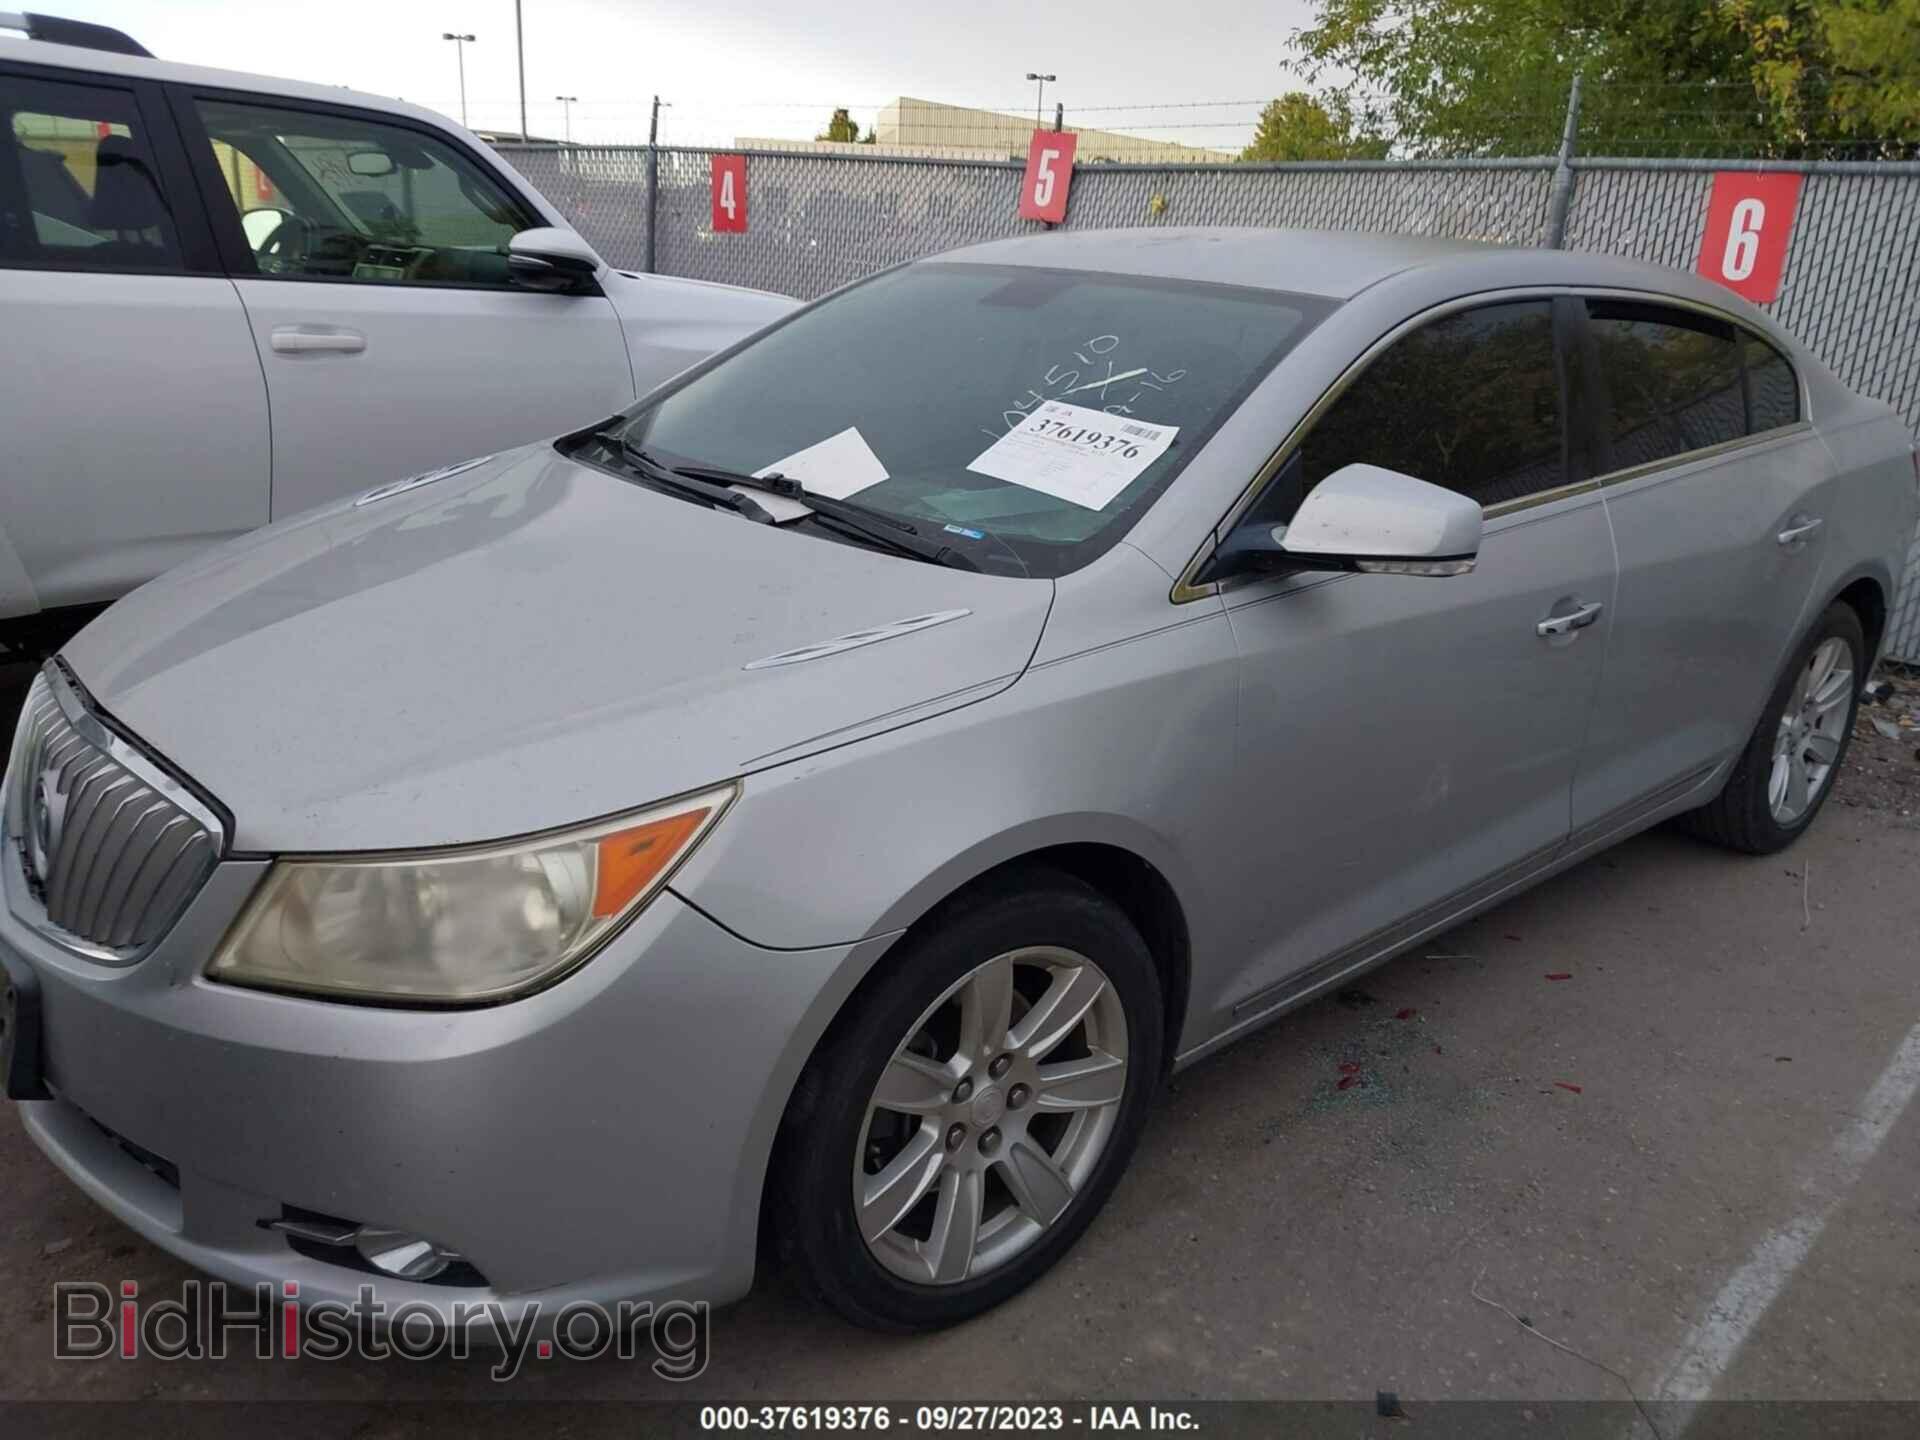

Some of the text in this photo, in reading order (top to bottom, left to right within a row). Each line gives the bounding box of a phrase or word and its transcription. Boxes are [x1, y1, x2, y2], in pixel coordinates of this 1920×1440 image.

[720, 170, 736, 220] 4
[1034, 148, 1060, 208] 5
[1721, 198, 1766, 281] 6
[1029, 418, 1143, 459] 37619376
